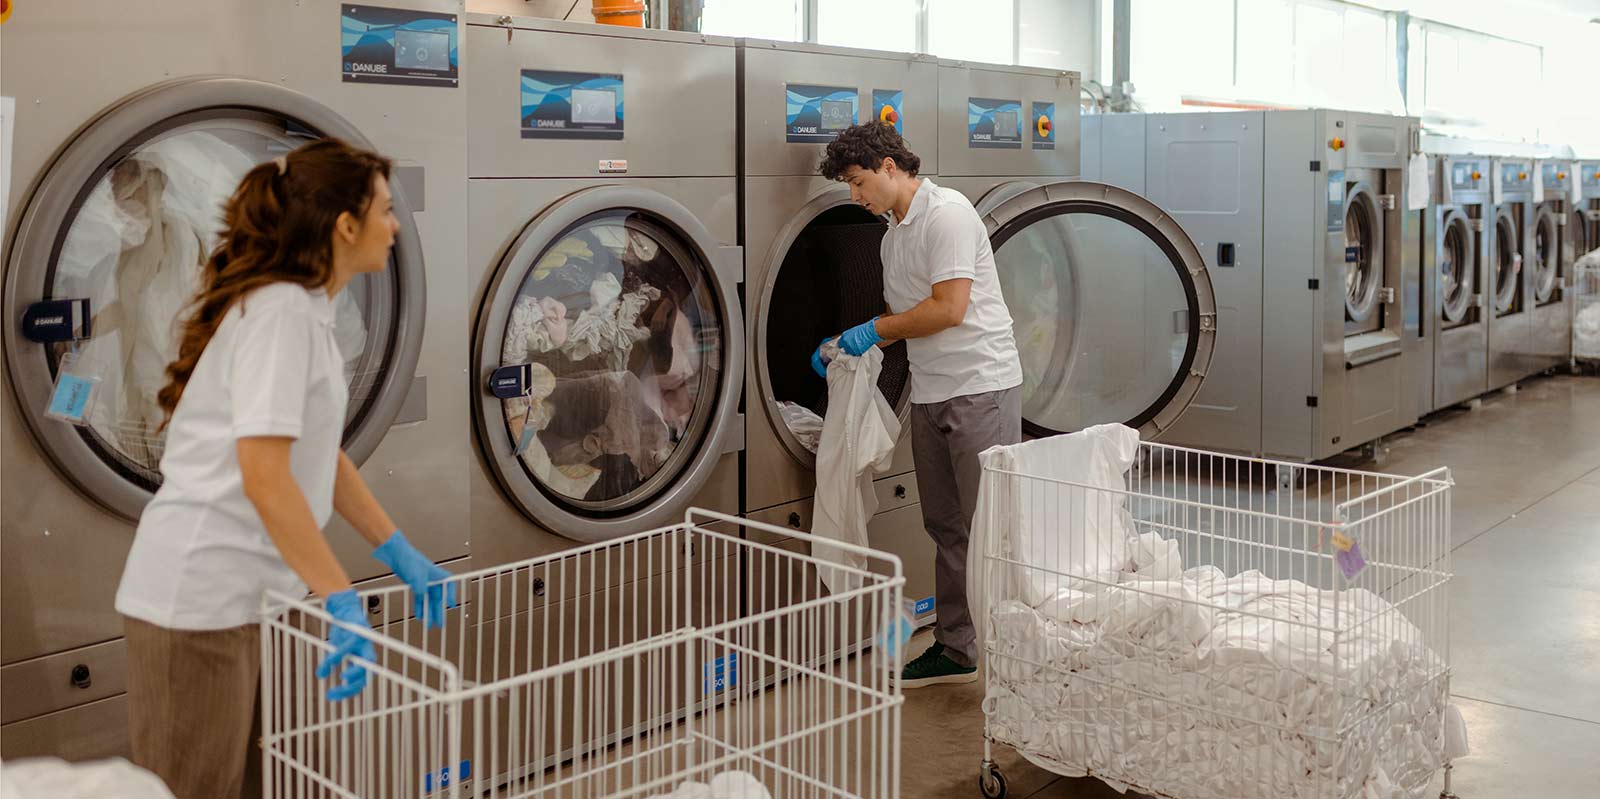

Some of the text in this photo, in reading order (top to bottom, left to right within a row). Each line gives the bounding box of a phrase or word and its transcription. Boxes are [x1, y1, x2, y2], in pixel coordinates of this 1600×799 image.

[352, 63, 387, 73] DANUBE
[537, 119, 565, 128] DANUBE
[797, 126, 817, 134] DANUBE
[40, 316, 64, 325] DANUBE
